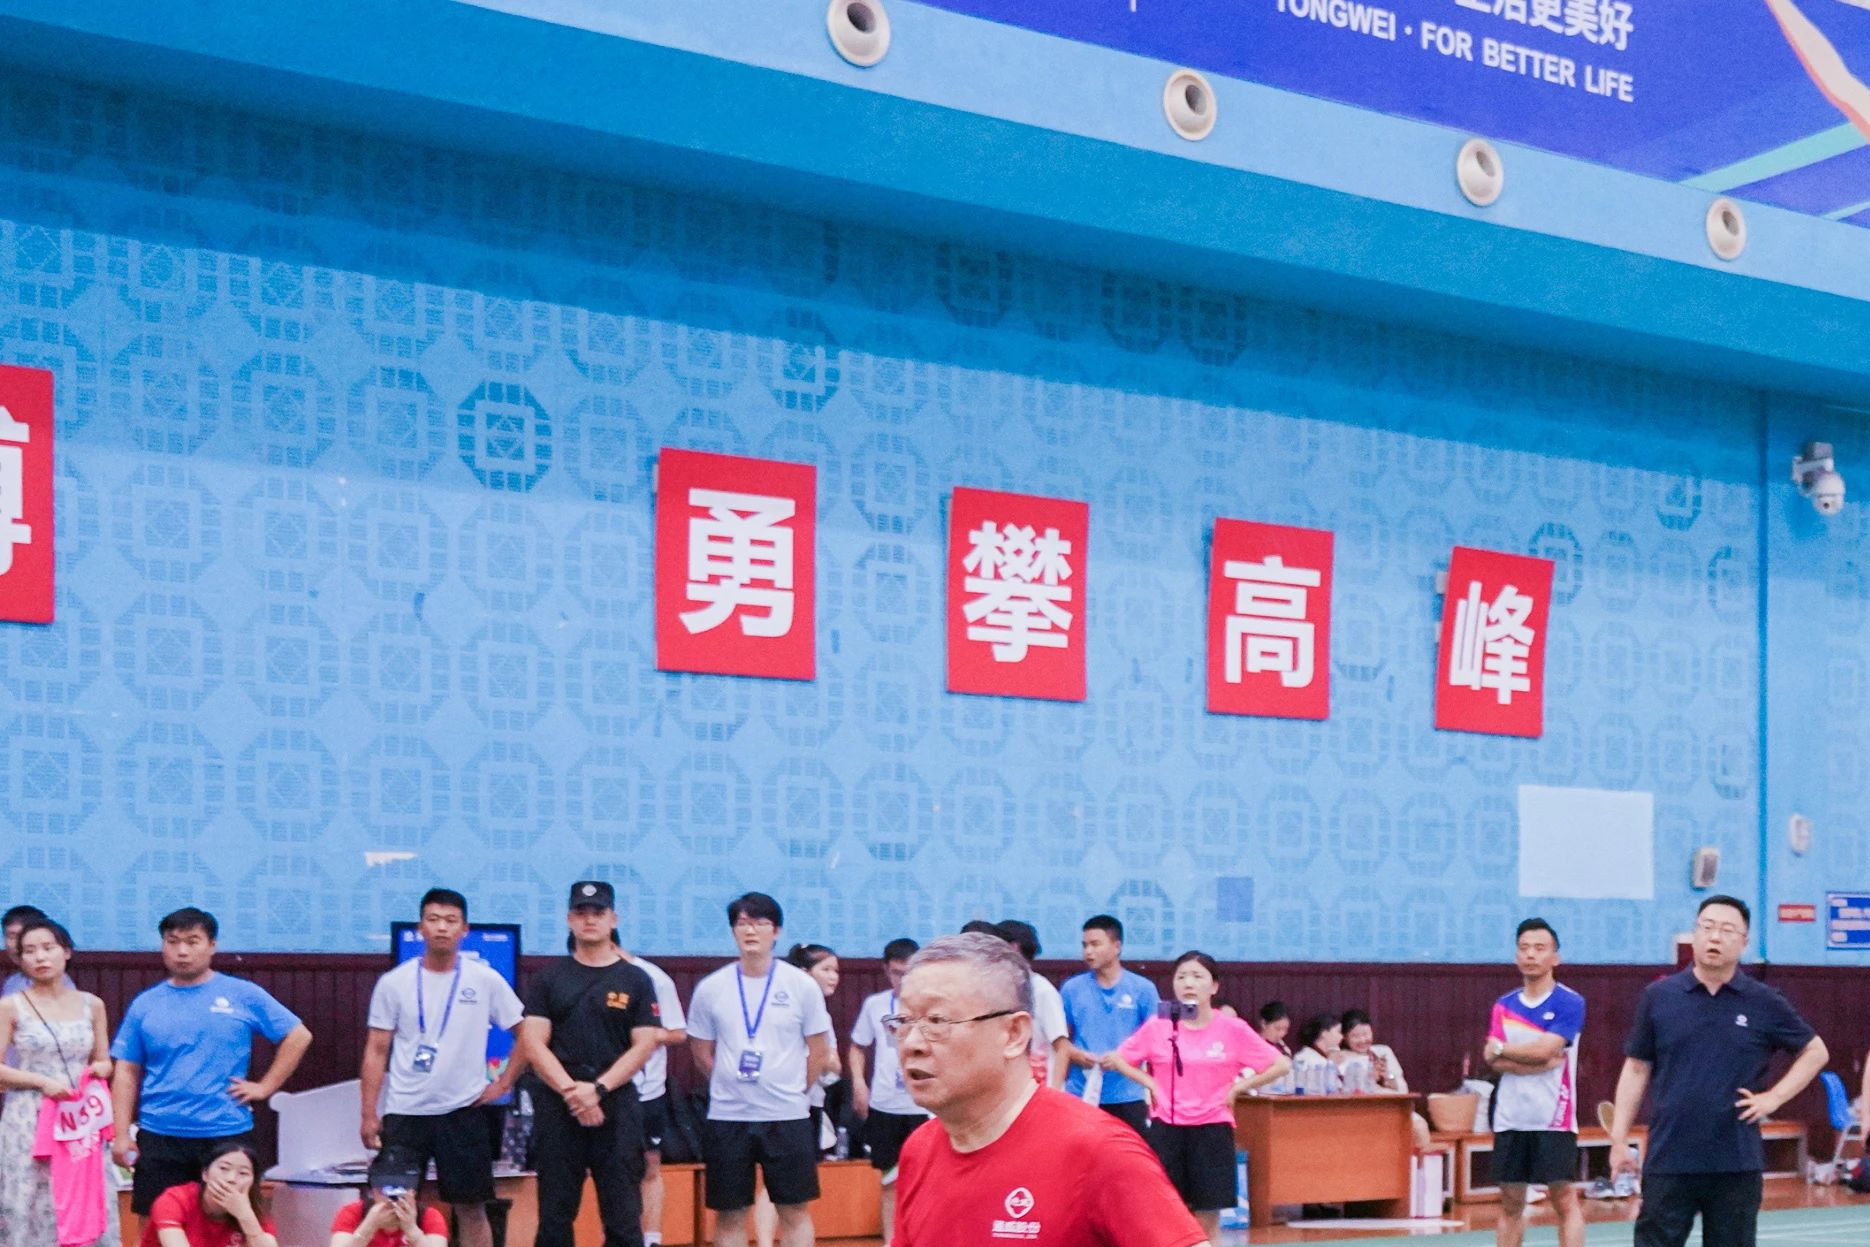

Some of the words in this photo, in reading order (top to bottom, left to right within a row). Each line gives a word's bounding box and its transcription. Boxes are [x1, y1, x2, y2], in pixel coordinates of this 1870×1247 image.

[1421, 22, 1474, 62] FOR
[1483, 38, 1576, 88] BETTER
[1585, 65, 1634, 103] LIFE
[1455, 0, 1634, 51] 更美好
[680, 487, 796, 638] 勇
[962, 520, 1074, 663] 攀
[1223, 555, 1321, 689] 高
[1449, 580, 1536, 706] 峰
